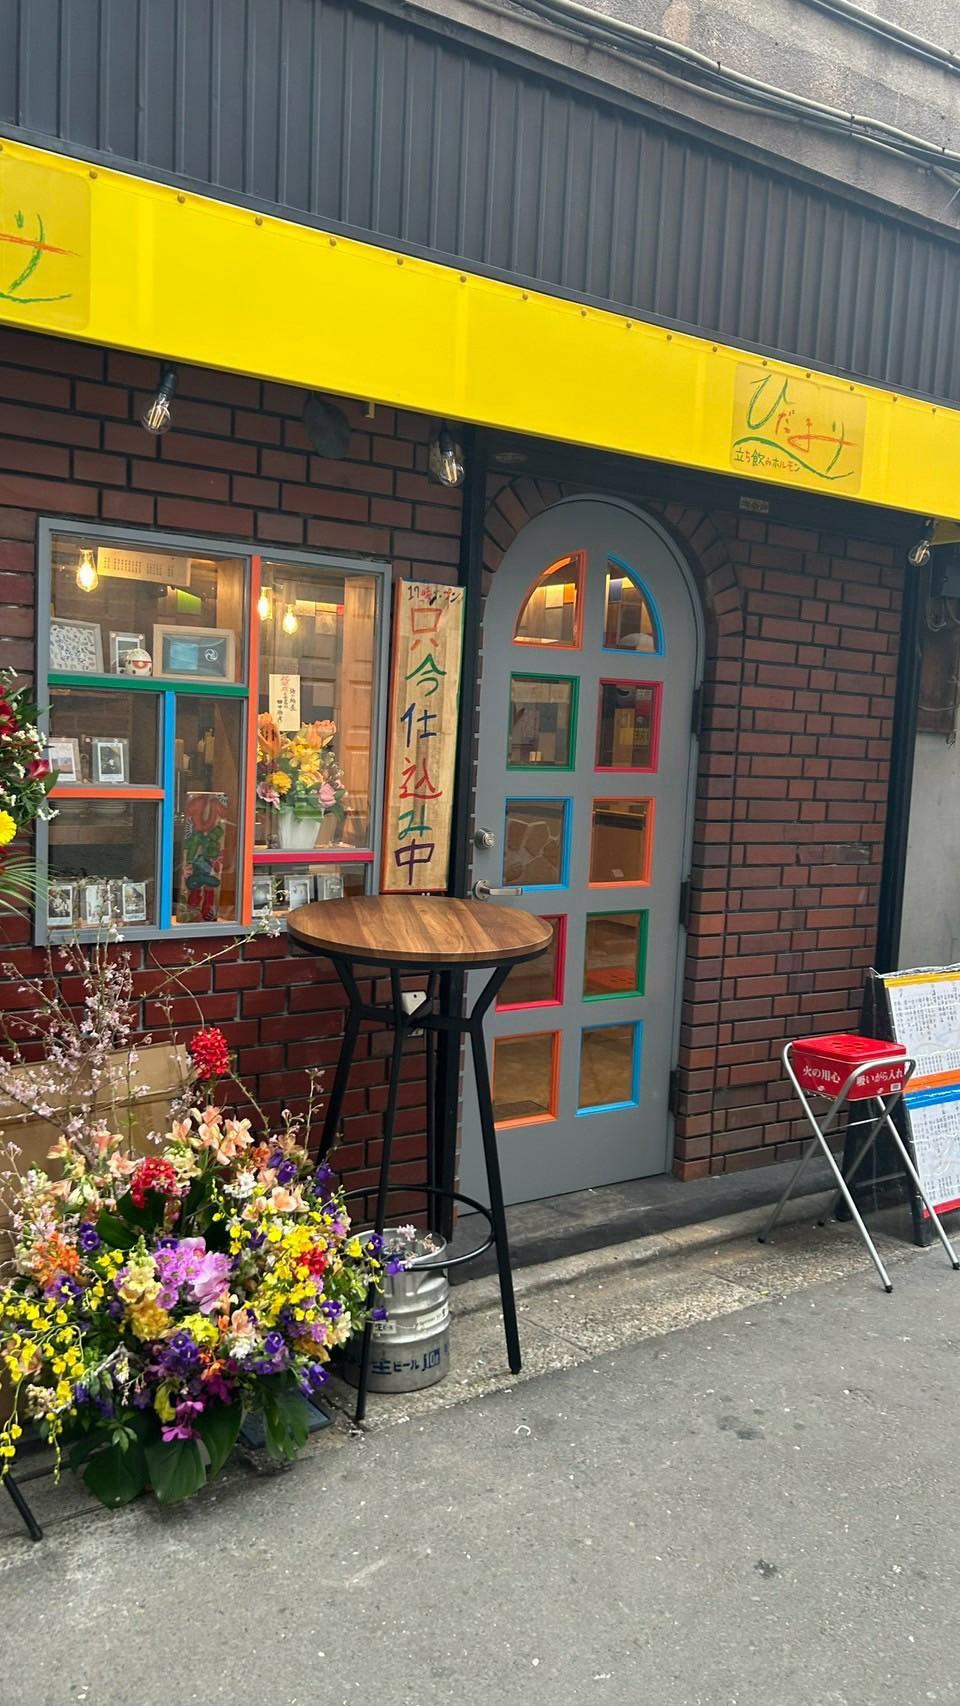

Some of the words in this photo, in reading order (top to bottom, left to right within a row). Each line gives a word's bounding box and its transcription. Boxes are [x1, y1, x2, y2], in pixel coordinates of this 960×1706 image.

[733, 448, 802, 473] 立ち飲みホルモン
[394, 607, 447, 886] 只今仕込み中
[803, 1065, 841, 1084] 火の用心
[855, 1067, 903, 1087] 吸いがら入れ
[371, 1358, 420, 1375] 生ビール
